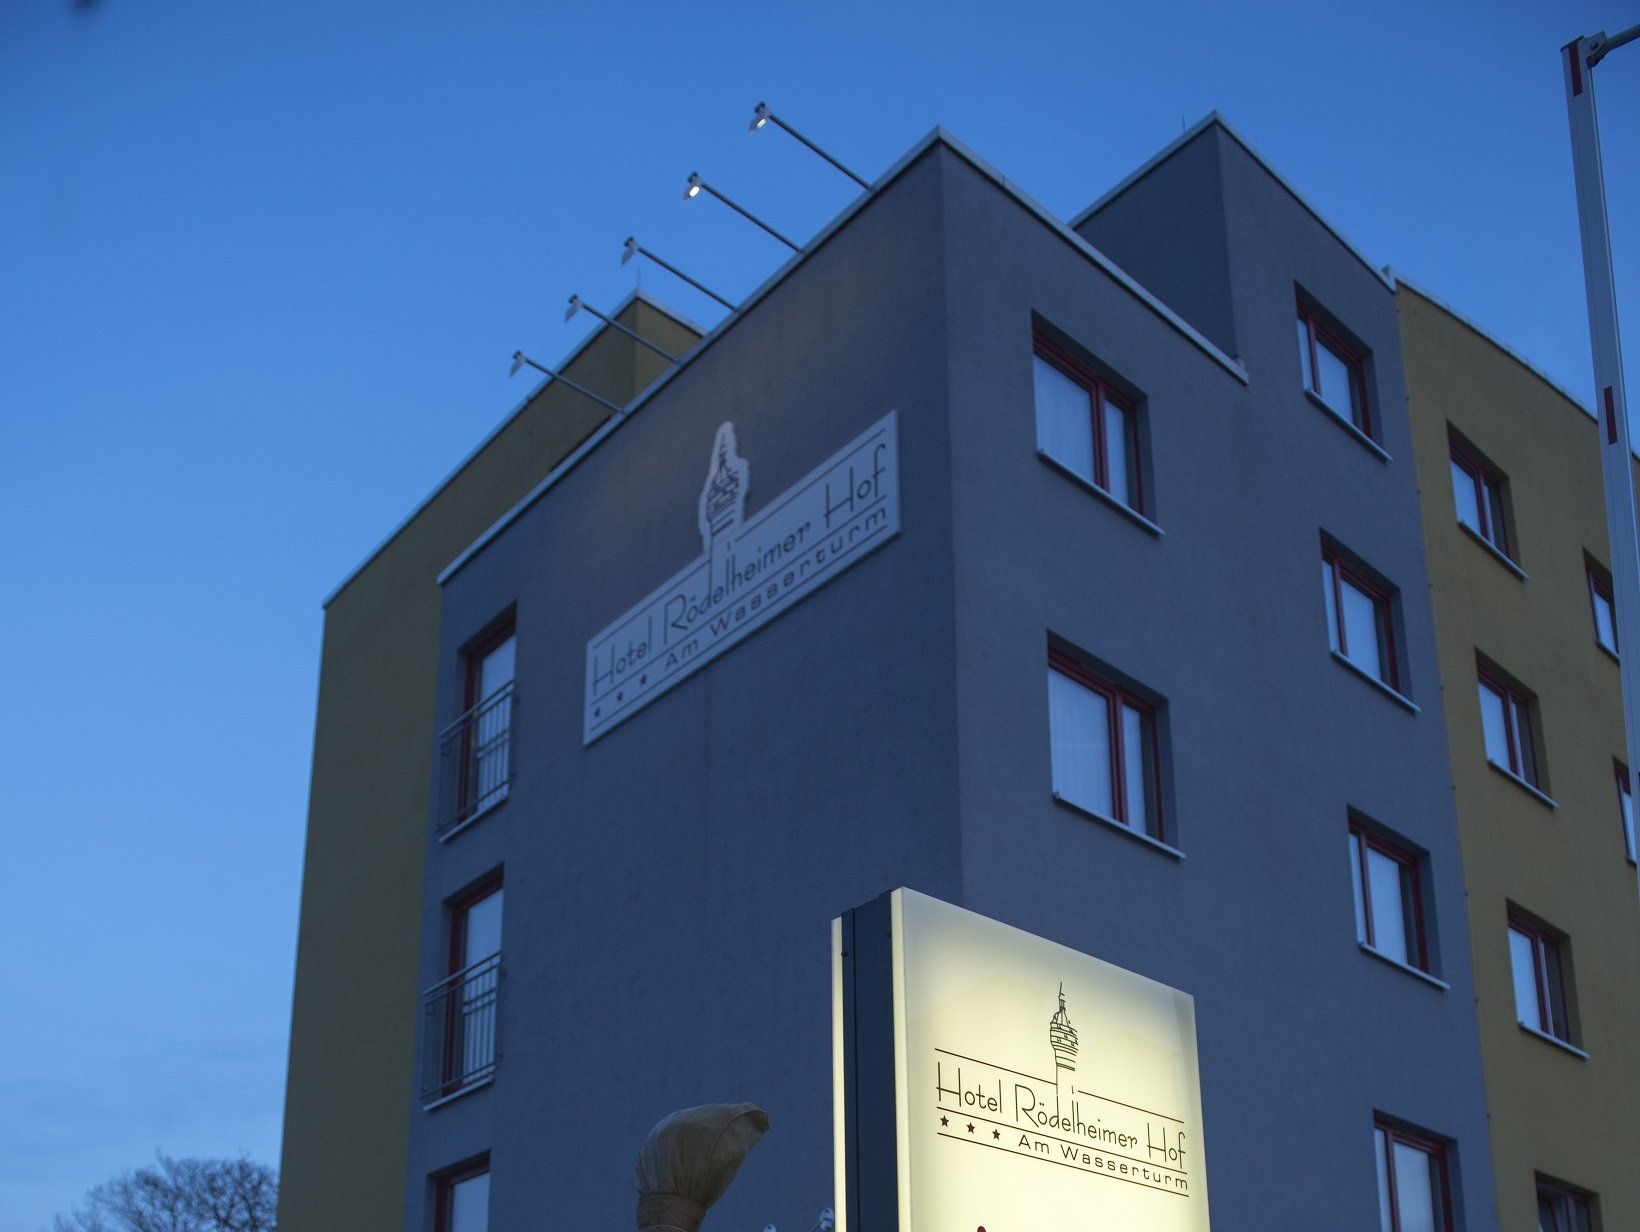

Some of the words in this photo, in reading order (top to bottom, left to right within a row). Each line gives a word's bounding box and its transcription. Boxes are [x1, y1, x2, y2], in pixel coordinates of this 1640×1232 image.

[592, 615, 652, 697] Hotel
[663, 521, 811, 645] Rödelheimer
[824, 442, 887, 530] Hof
[664, 639, 699, 672] Am
[710, 506, 887, 637] Wasserturm
[936, 1061, 1003, 1113] Hotel
[1014, 1083, 1138, 1150] Rödelheimer
[1147, 1122, 1187, 1169] Hof
[1018, 1134, 1050, 1154] Am
[1060, 1144, 1189, 1190] Wasserturm
